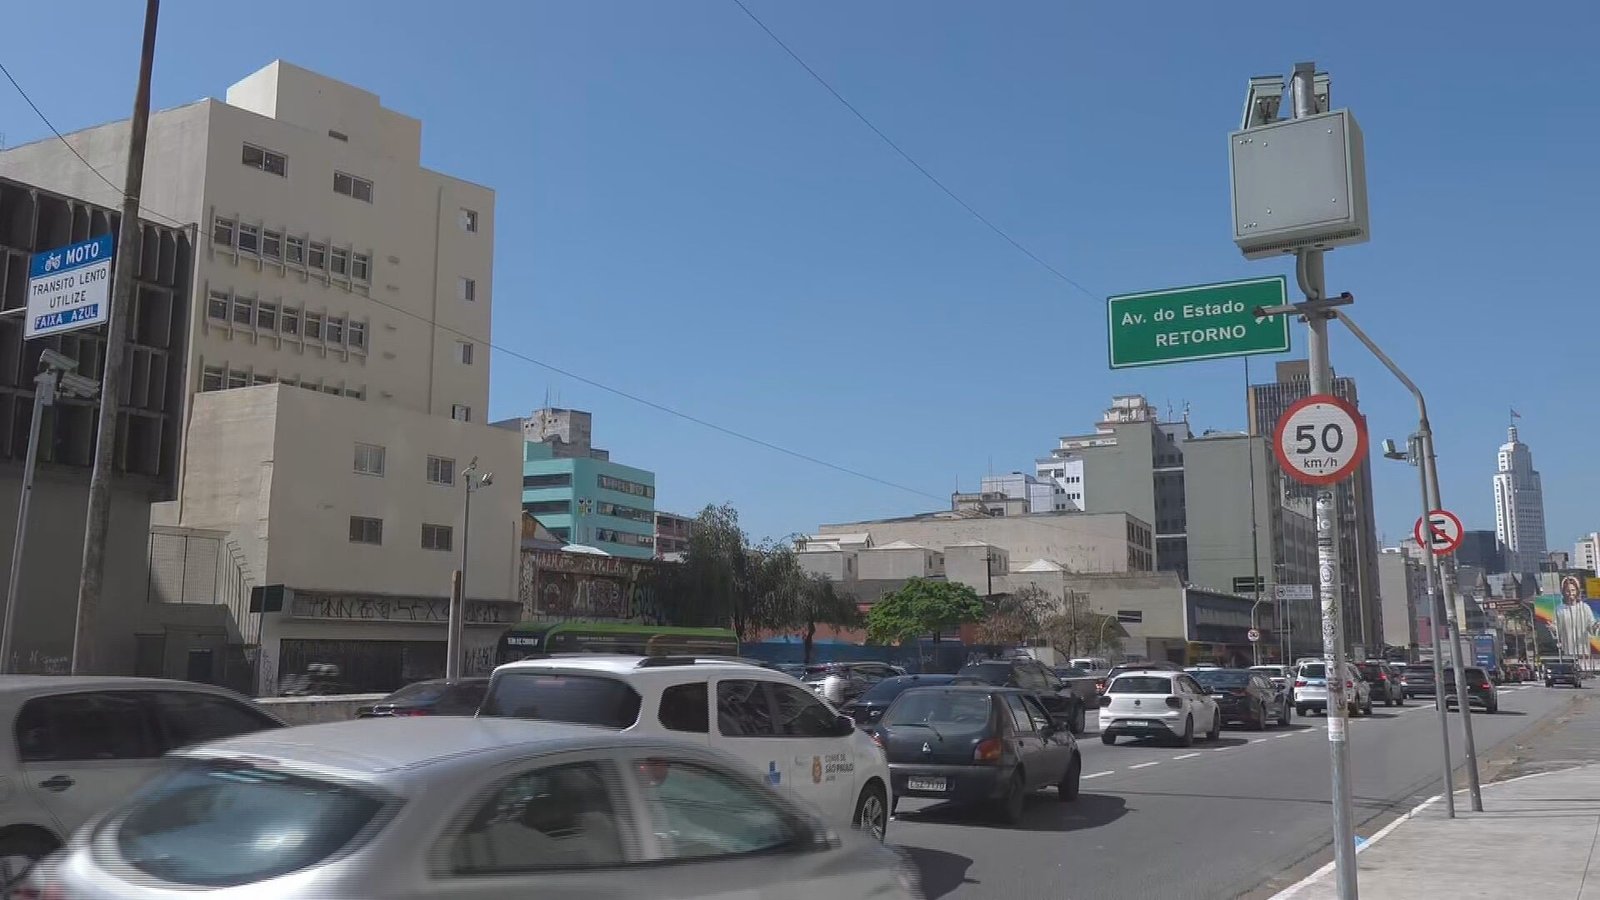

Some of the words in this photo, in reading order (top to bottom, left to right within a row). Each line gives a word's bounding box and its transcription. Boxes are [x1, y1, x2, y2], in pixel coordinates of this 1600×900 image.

[66, 242, 99, 265] MOTO
[33, 277, 75, 296] TRANSITO
[80, 268, 106, 285] LENTO
[49, 290, 87, 308] UTILIZE
[35, 313, 63, 330] FAIXA
[71, 305, 96, 322] AZUL
[1121, 312, 1147, 326] Av.
[1153, 308, 1175, 321] do
[1183, 300, 1244, 319] Estado
[1156, 325, 1246, 347] RETORNO
[1296, 423, 1343, 454] 50
[1303, 457, 1338, 468] km/h
